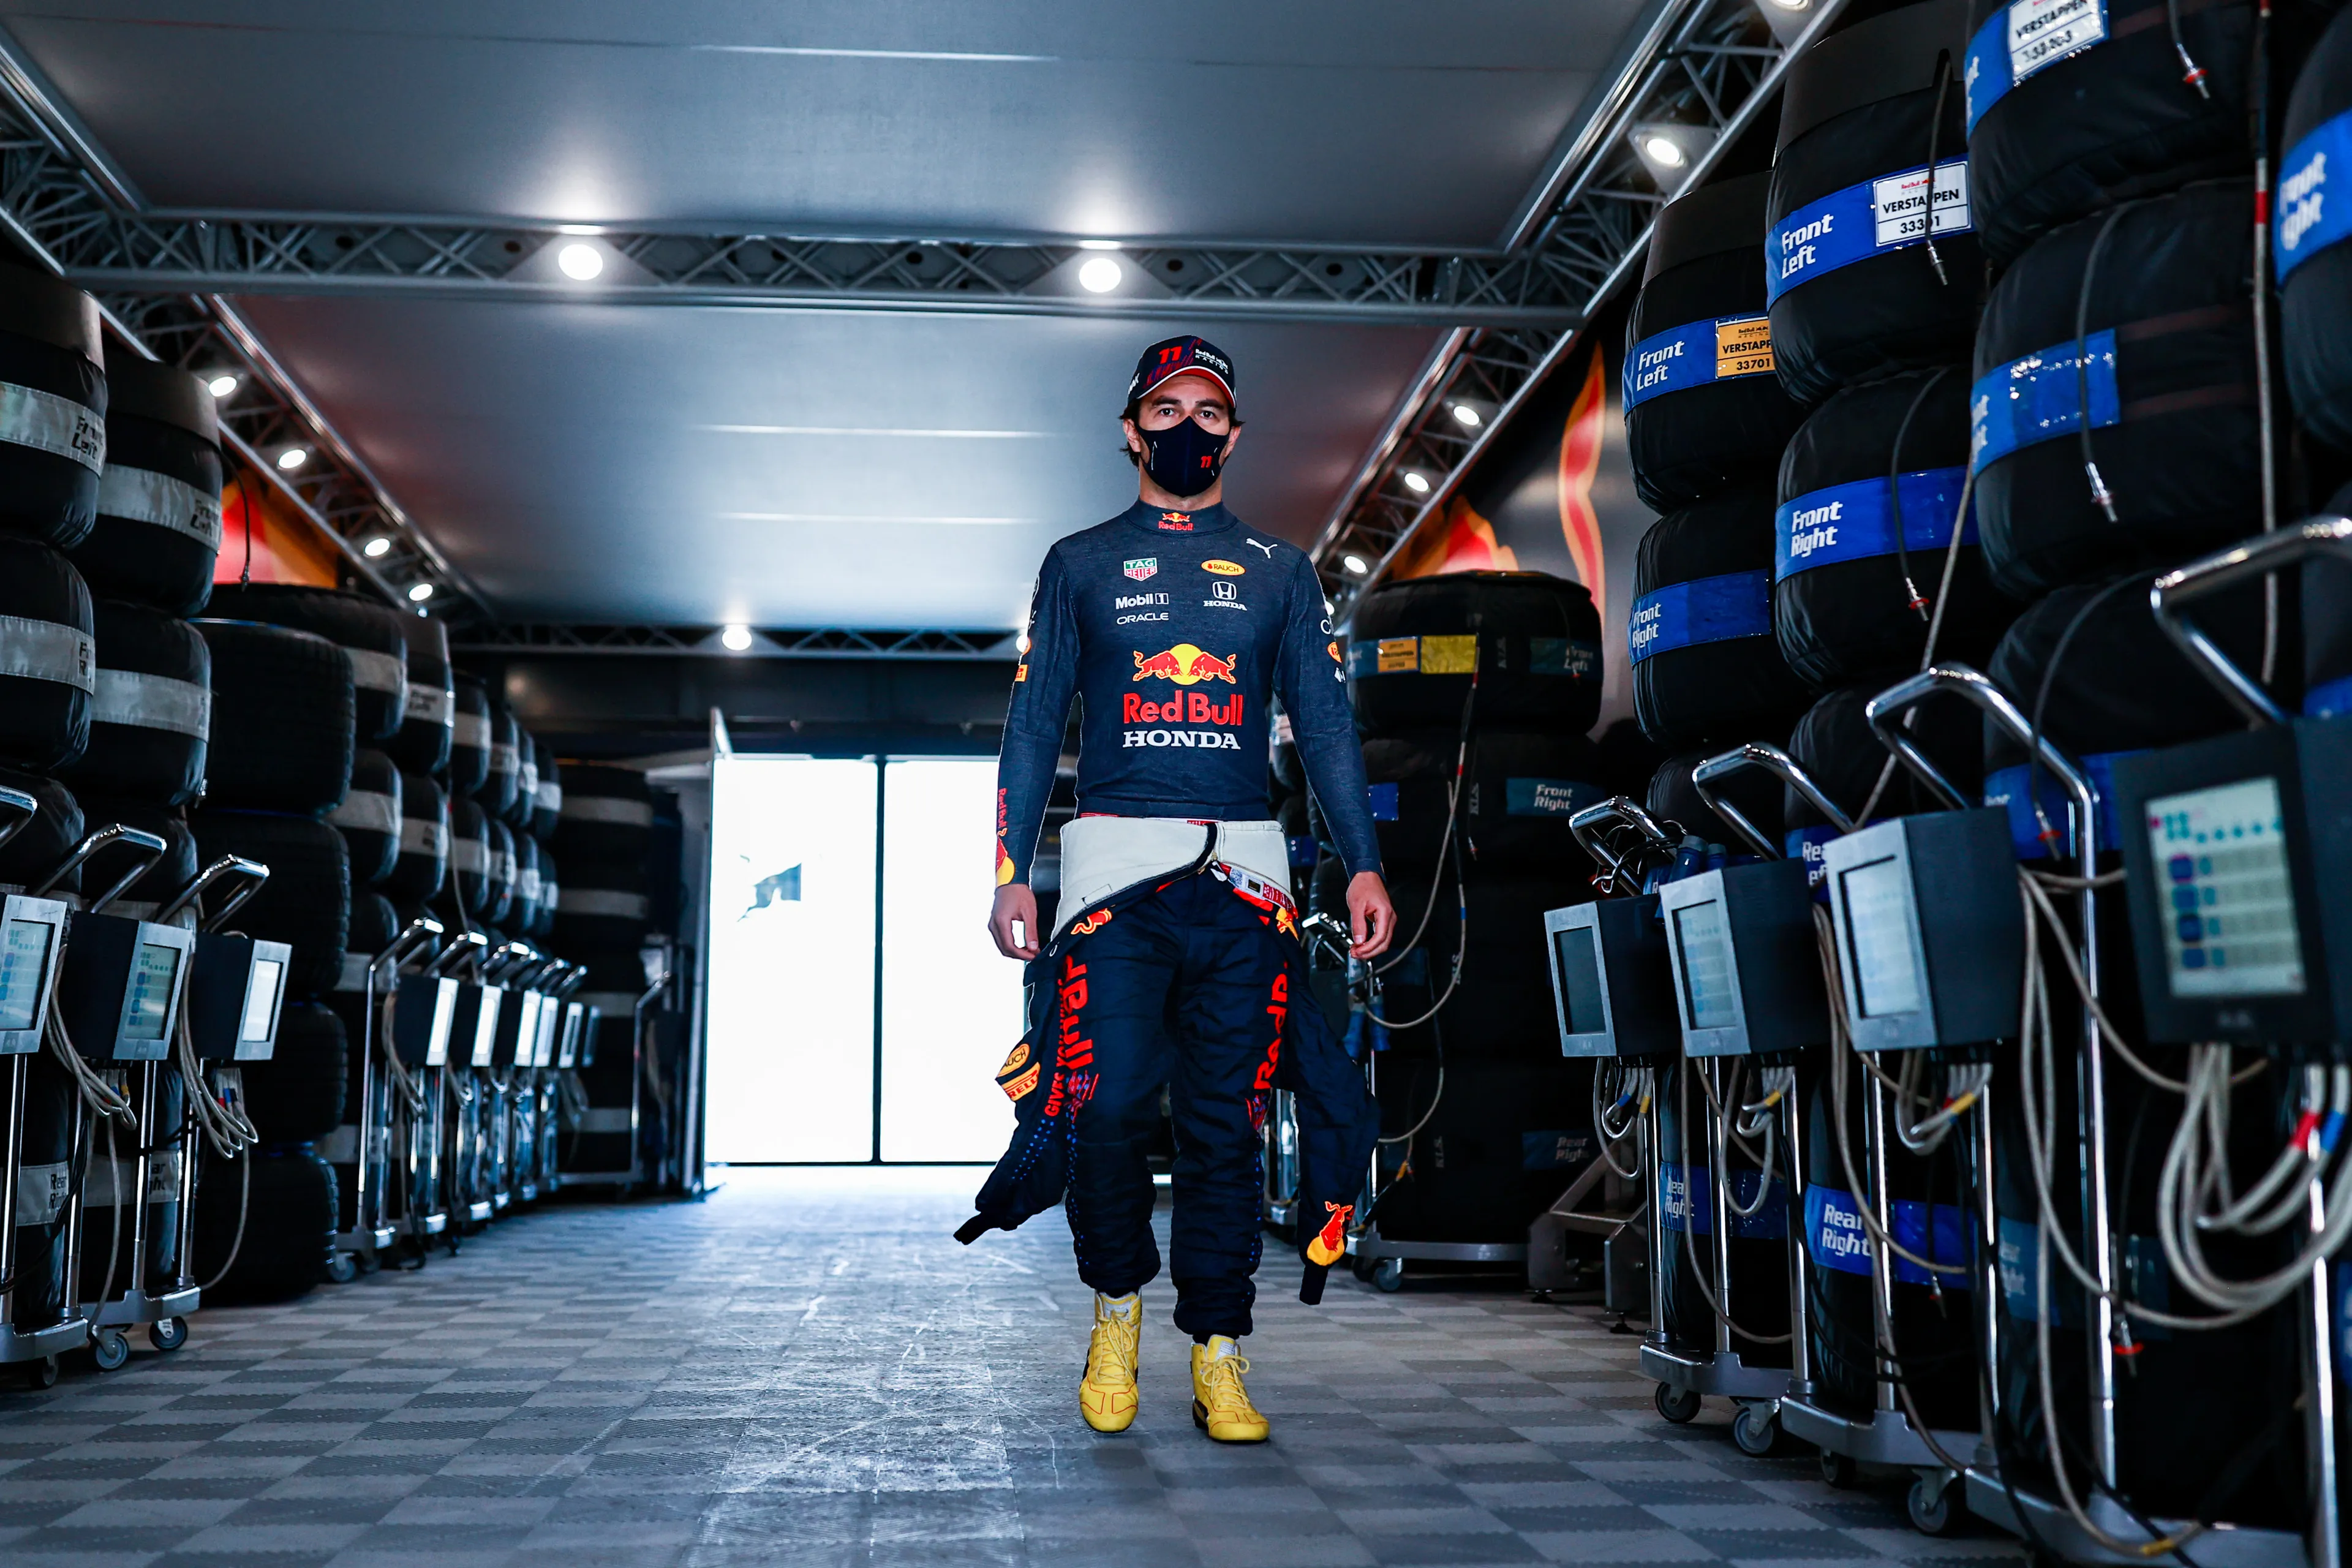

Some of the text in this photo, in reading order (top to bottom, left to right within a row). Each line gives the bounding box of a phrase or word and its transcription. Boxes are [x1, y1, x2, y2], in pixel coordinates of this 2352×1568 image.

[1883, 189, 1959, 213] VERSTAPEN
[1781, 213, 1834, 254] Front
[1900, 216, 1940, 233] 3331
[1781, 245, 1815, 279] Left
[1159, 346, 1183, 364] 11
[1722, 339, 1772, 354] VERSTAPP
[1206, 352, 1215, 360] Bull
[1638, 341, 1685, 371] Front
[1736, 358, 1770, 371] 33701
[1637, 365, 1668, 391] Left
[1200, 456, 1212, 468] 11
[1158, 521, 1175, 530] Red
[1792, 501, 1843, 533] Front
[1791, 526, 1838, 558] Right
[1126, 559, 1155, 568] TAG
[1213, 564, 1239, 573] RAUCH
[1125, 567, 1156, 581] HEUER
[1115, 593, 1153, 609] Mobil
[1203, 600, 1248, 611] HONDA
[1117, 612, 1169, 625] ORACLE
[1632, 603, 1661, 628] Front
[1632, 623, 1659, 648] Right
[1123, 690, 1243, 726] Red Bull
[1122, 729, 1241, 750] HONDA
[998, 788, 1008, 810] Red
[1536, 784, 1574, 798] Front
[1534, 796, 1571, 812] Right
[1003, 1049, 1027, 1067] AUCH
[1008, 1073, 1038, 1098] RELL
[1822, 1227, 1871, 1257] Right
